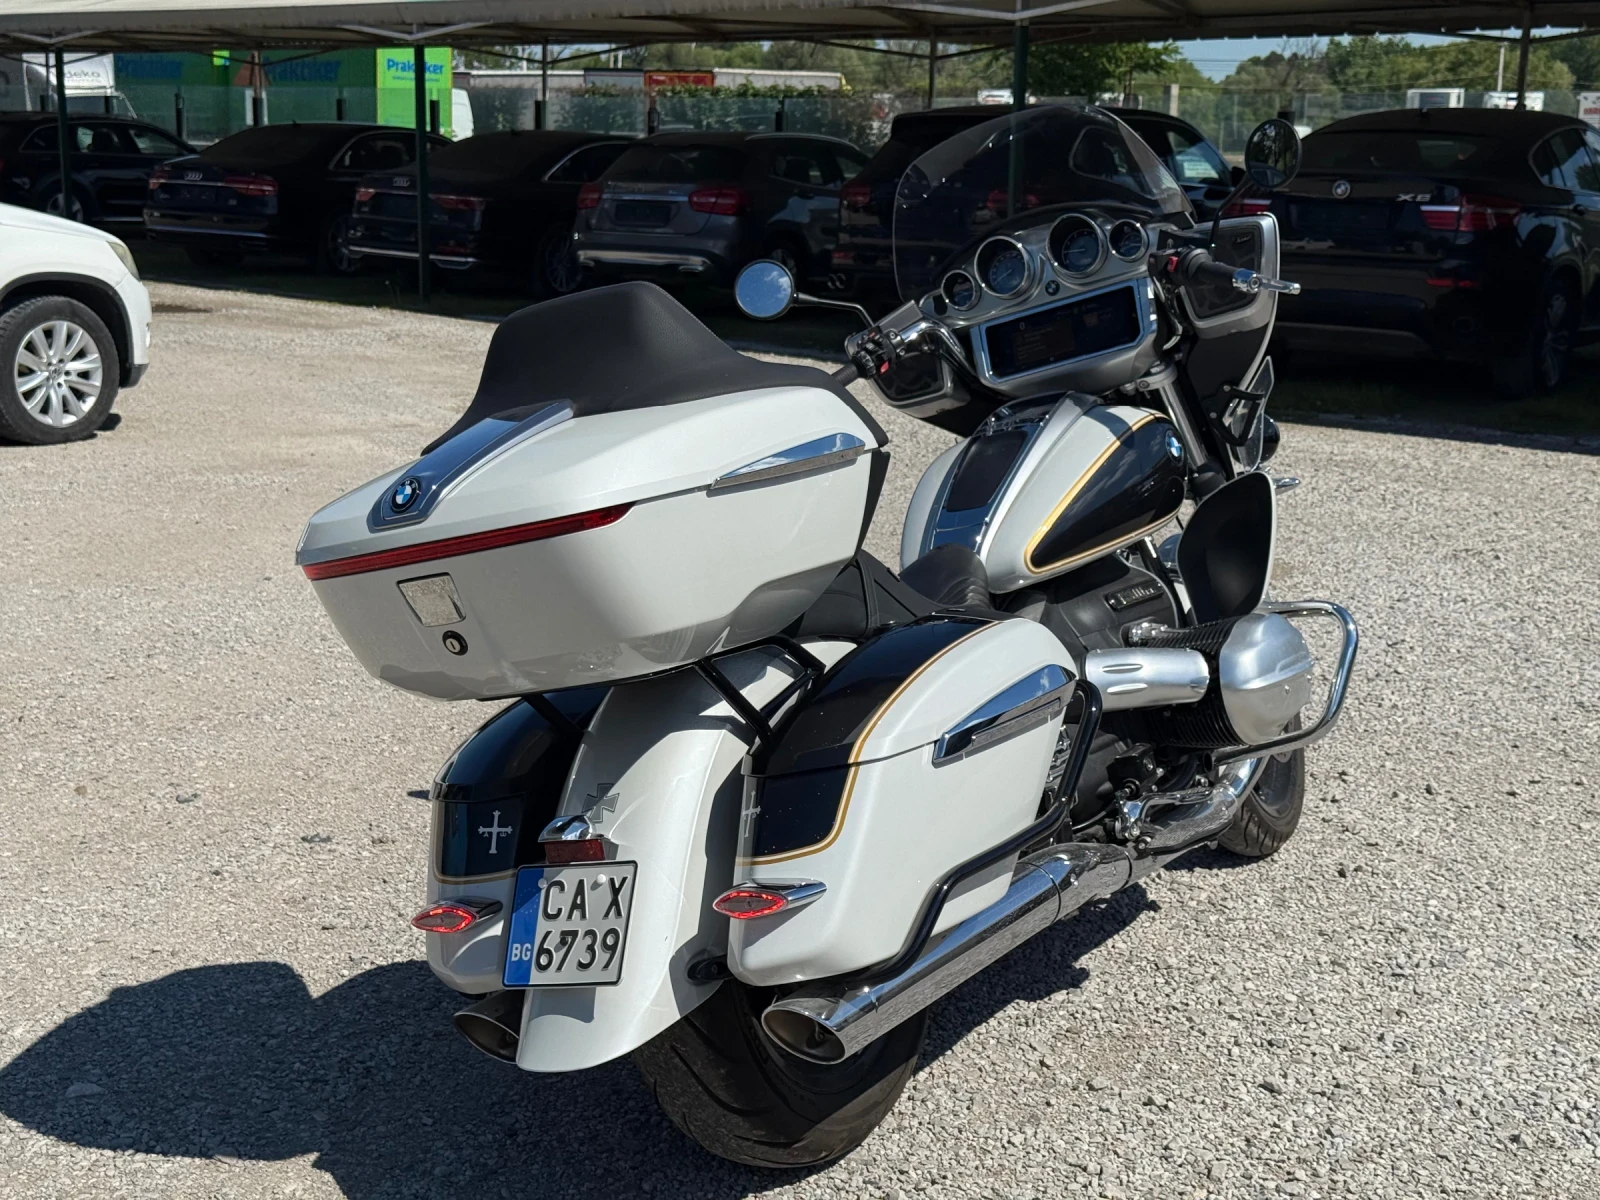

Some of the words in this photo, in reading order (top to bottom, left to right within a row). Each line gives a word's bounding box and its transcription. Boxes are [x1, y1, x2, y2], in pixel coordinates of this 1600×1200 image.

[386, 57, 444, 75] Prakker
[543, 879, 588, 921] CA
[602, 875, 628, 920] X
[511, 942, 532, 962] BG
[535, 928, 620, 972] 6739
